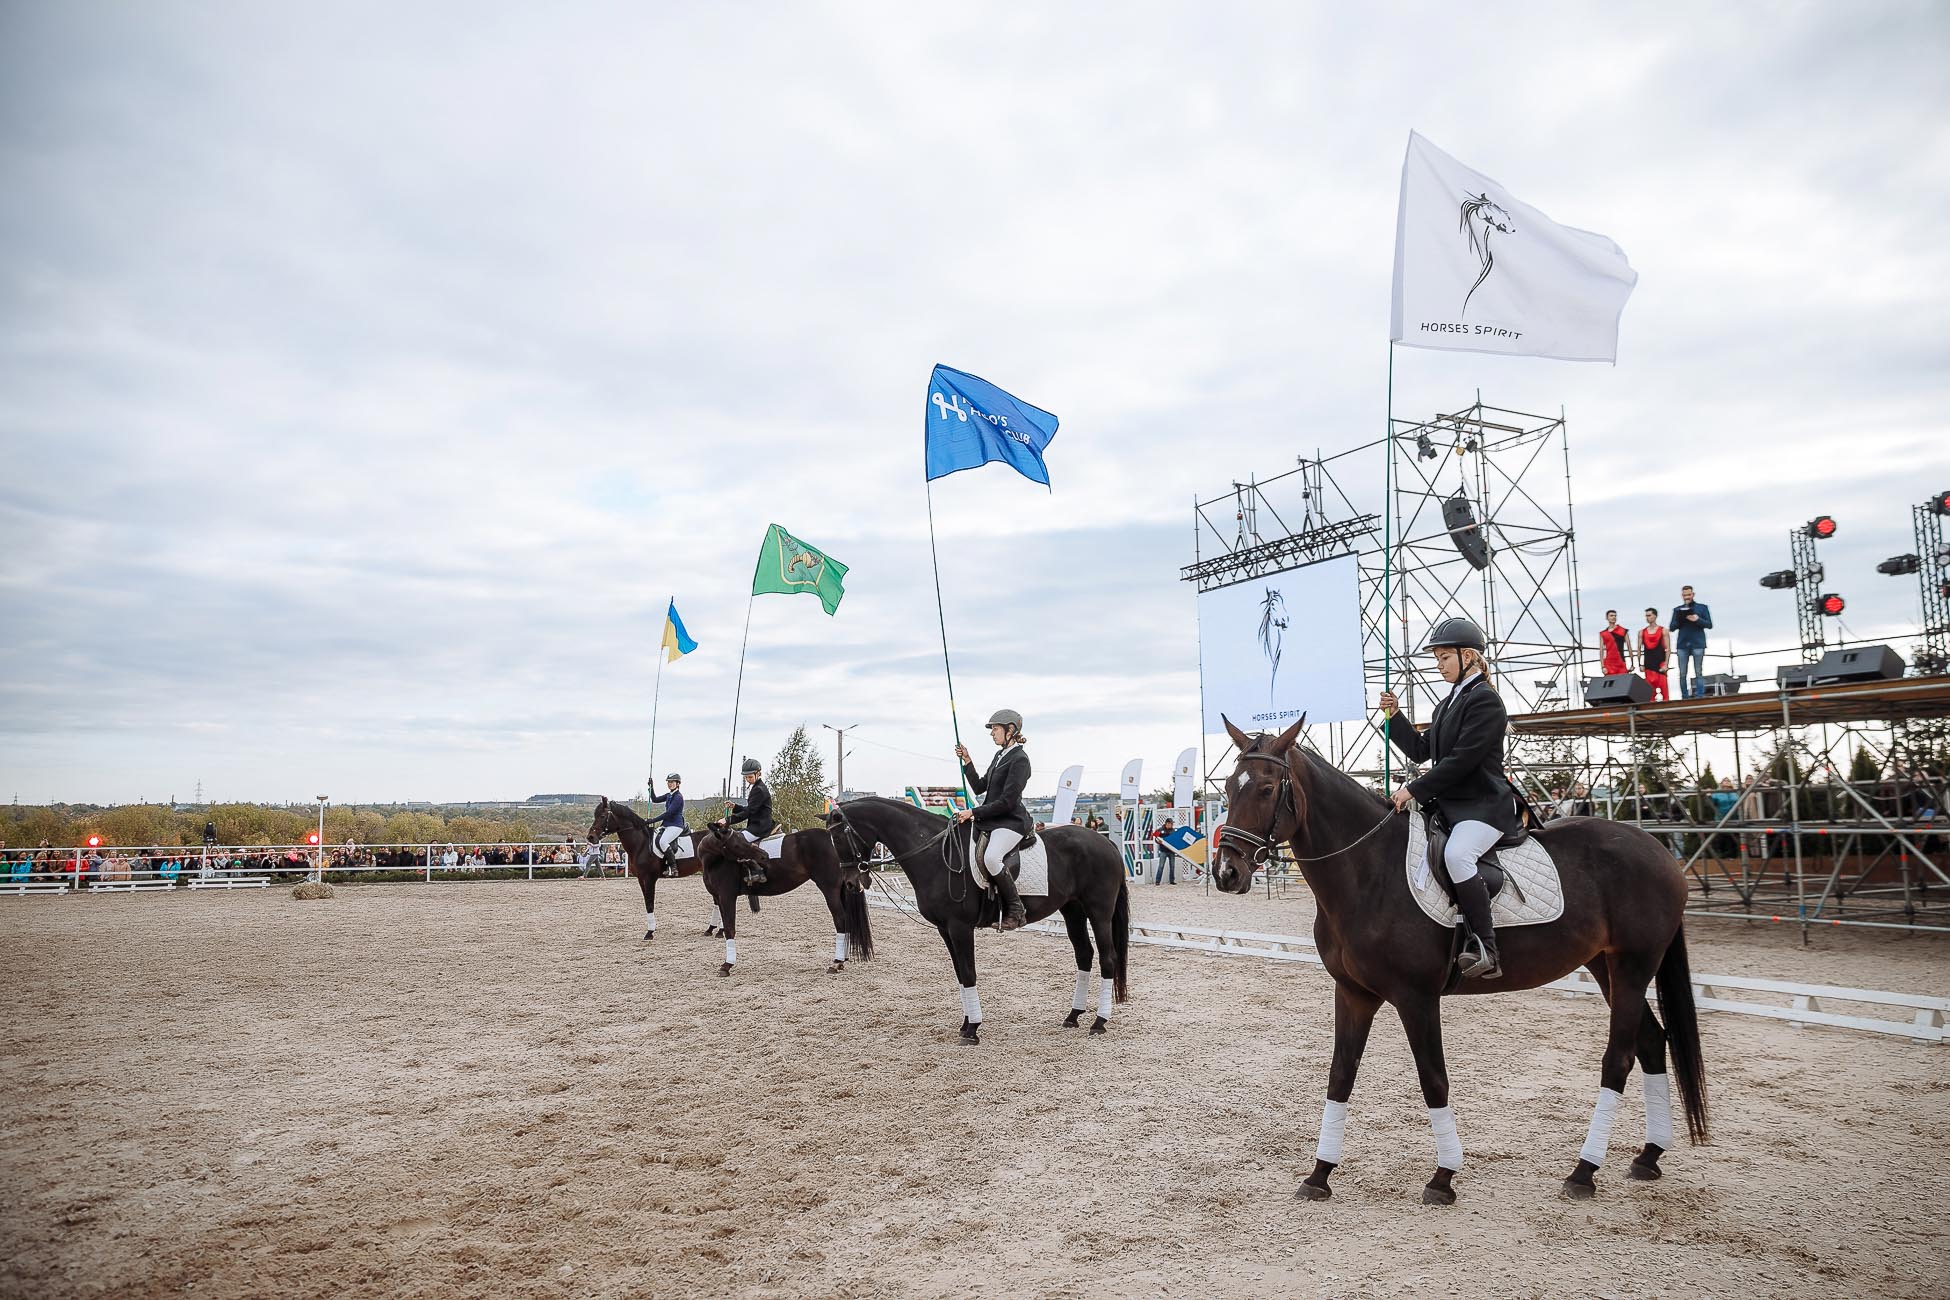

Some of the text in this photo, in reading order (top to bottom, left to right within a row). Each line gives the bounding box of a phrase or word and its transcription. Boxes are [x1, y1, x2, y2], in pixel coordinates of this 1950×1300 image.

[1420, 322, 1523, 340] HORSES SPIRIT
[1251, 709, 1300, 722] HORSES SPIRIT
